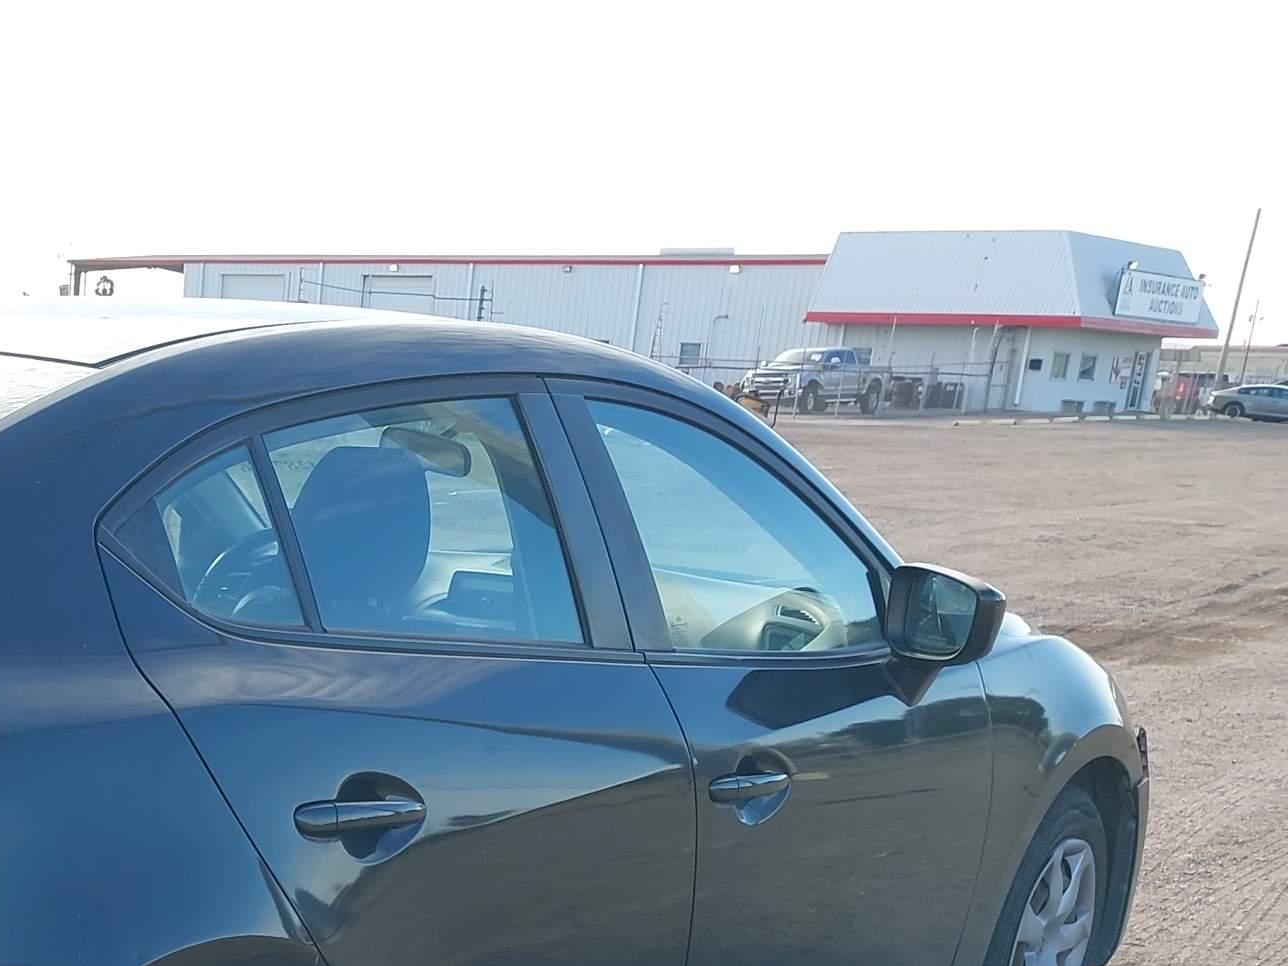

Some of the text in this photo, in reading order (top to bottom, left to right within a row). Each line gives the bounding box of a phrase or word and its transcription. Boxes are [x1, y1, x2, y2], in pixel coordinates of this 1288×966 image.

[1139, 279, 1181, 298] INSURANCE
[1181, 285, 1200, 300] AUTO
[1149, 298, 1184, 316] AUCTIONS
